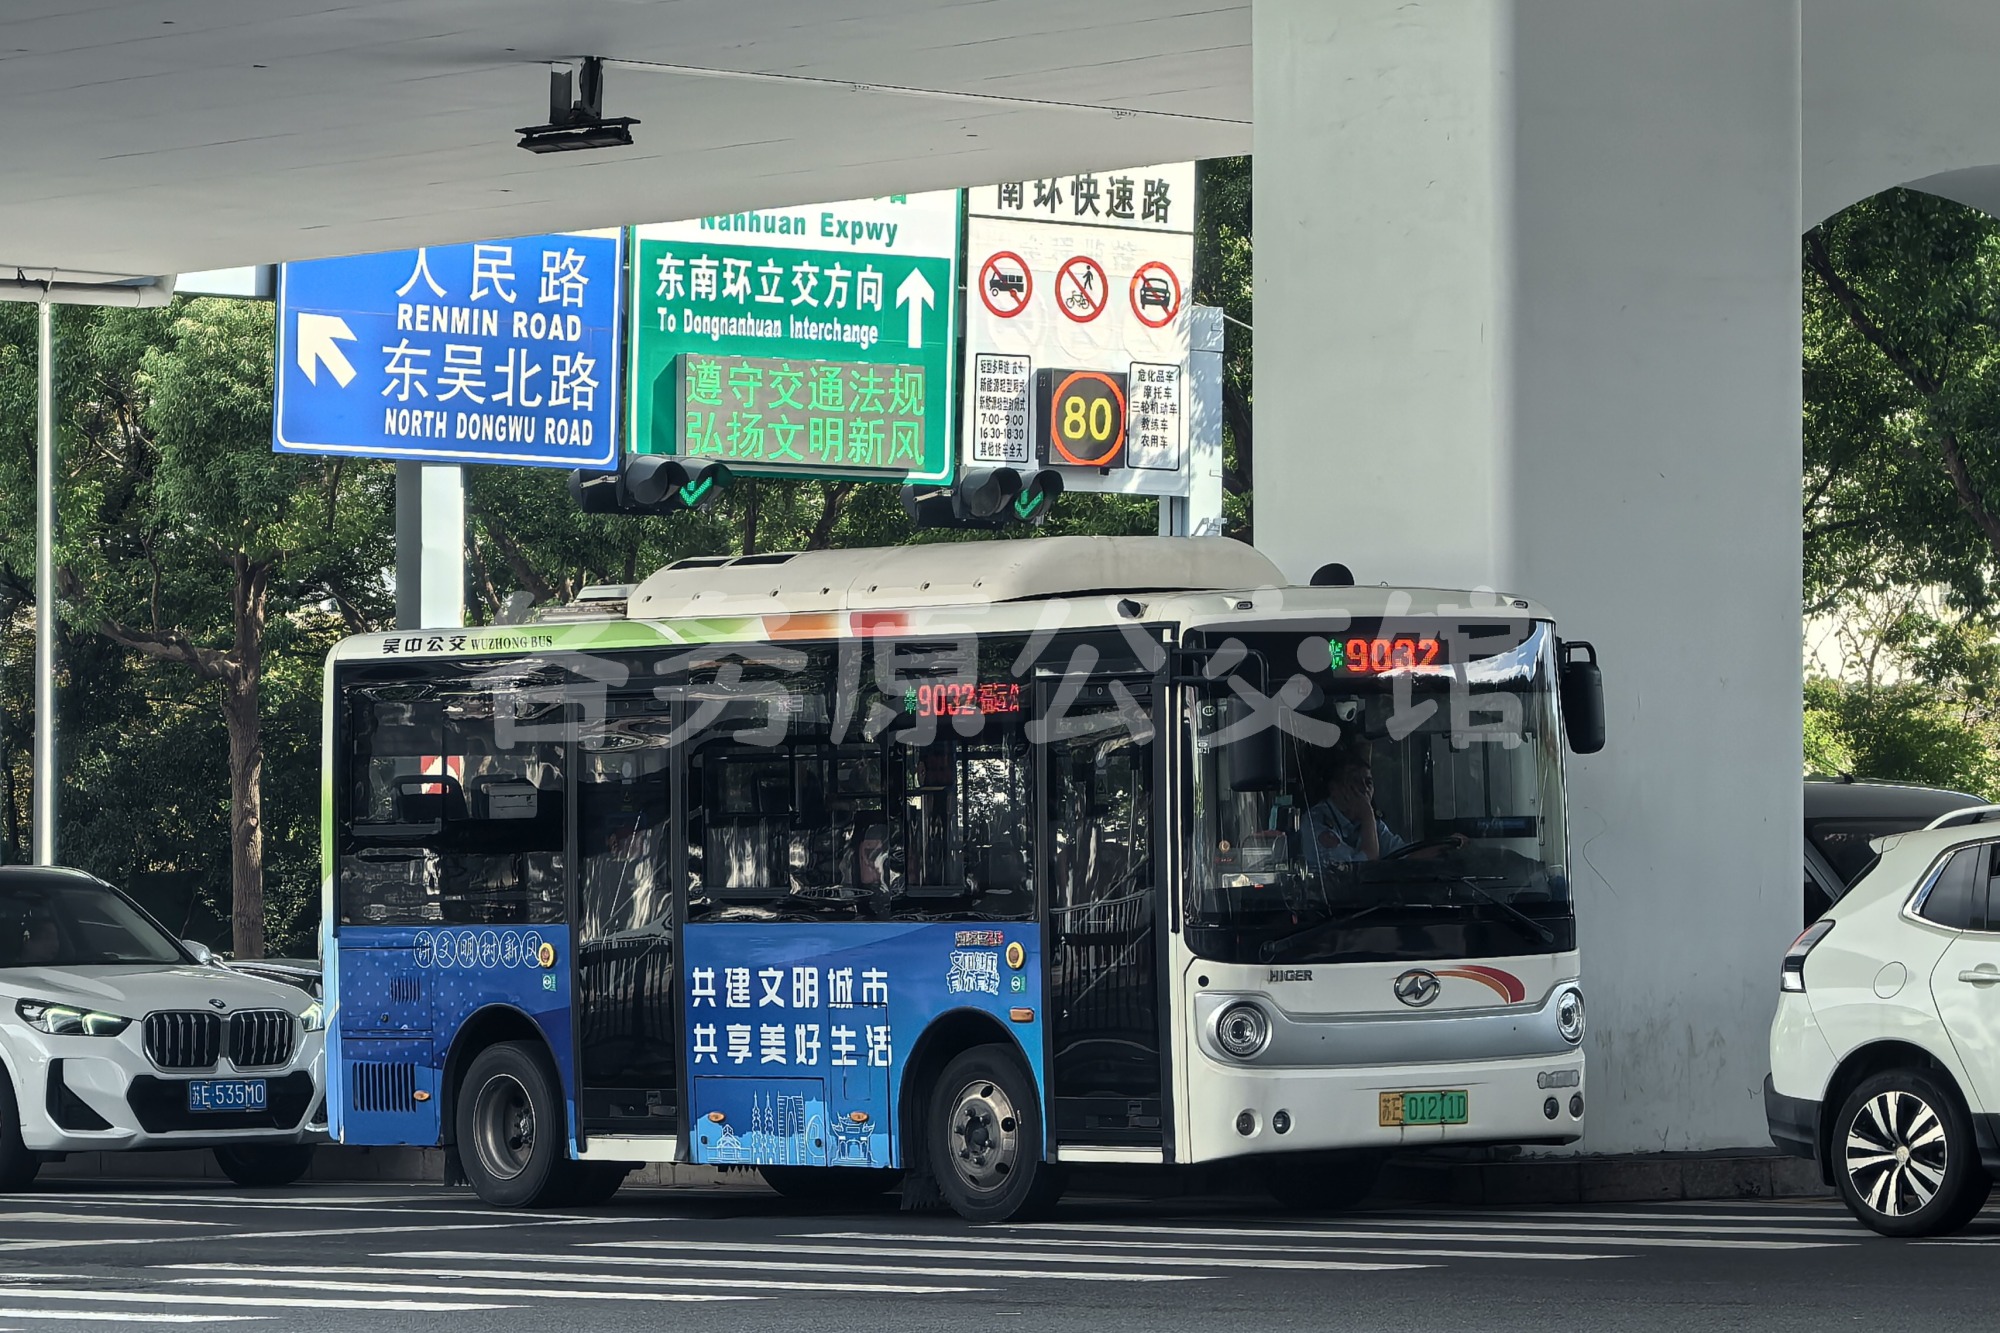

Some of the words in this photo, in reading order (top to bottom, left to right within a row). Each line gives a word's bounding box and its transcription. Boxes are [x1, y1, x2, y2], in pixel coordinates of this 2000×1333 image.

[997, 173, 1172, 224] 南环快速路
[700, 210, 806, 235] Nanhuan
[820, 212, 898, 247] Expwy
[395, 244, 590, 308] 人民路
[656, 252, 884, 312] 东南环立交方向
[397, 303, 498, 337] RENMIN
[512, 311, 582, 342] ROAD
[656, 307, 676, 332] To
[683, 308, 782, 341] Dongnanhuan
[789, 314, 878, 349] Interchange
[381, 338, 600, 412] 东吴北路
[686, 359, 925, 416] 遵守交通法规
[1143, 385, 1172, 400] 摩托车
[980, 413, 1024, 426] 7:00-9:00
[1064, 395, 1112, 441] 80
[1131, 400, 1178, 415] 三轮机动车
[1141, 417, 1168, 432] 教练车
[384, 408, 448, 439] NORTH
[456, 412, 535, 444] DONGWU
[544, 419, 594, 446] ROAD
[686, 411, 925, 466] 弘扬文明新风
[980, 427, 1024, 440] 16:30-18:30
[1140, 434, 1168, 449] 农用车
[382, 635, 467, 654] 吴中公交
[471, 637, 528, 651] WUZHONG
[531, 635, 553, 648] BUS
[1346, 638, 1439, 672] 9032
[918, 683, 976, 717] 9032
[414, 933, 541, 966] 讲文明树新风
[692, 966, 888, 1009] 共建文明城市
[1269, 969, 1313, 982] HIGER
[693, 1023, 893, 1067] 共享美好生活
